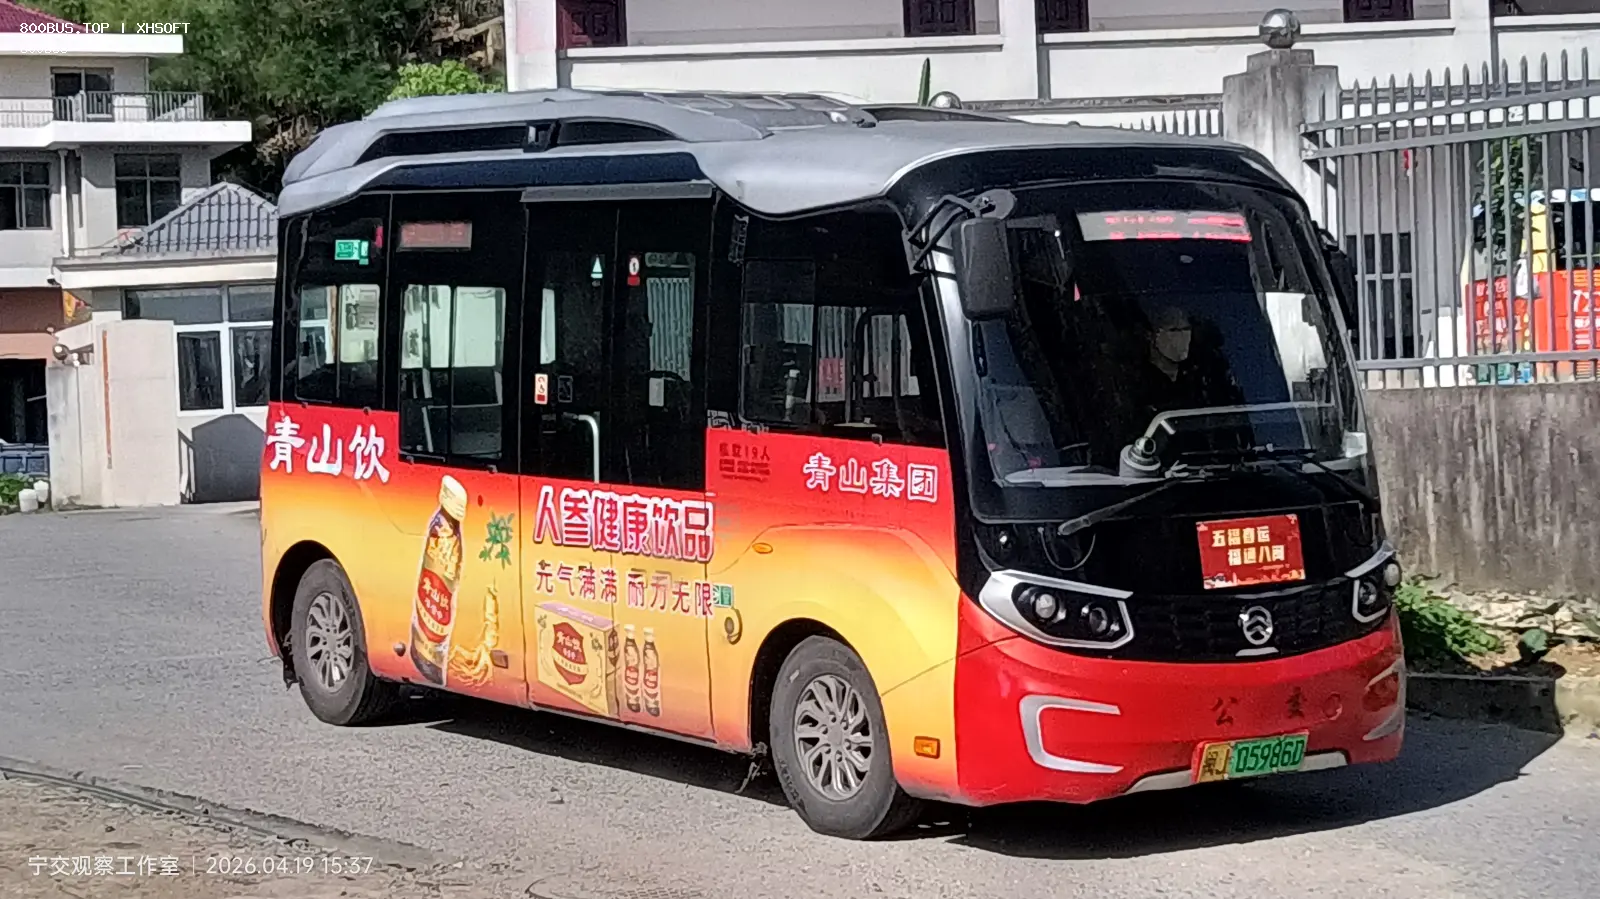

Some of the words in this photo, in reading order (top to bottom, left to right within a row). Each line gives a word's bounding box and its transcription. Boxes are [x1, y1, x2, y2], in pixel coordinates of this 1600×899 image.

[266, 415, 390, 484] 青山饮
[803, 452, 938, 503] 青山集团
[533, 485, 717, 563] 人参健康饮品
[535, 559, 618, 604] 元气满满
[626, 566, 715, 617] 耐力无限
